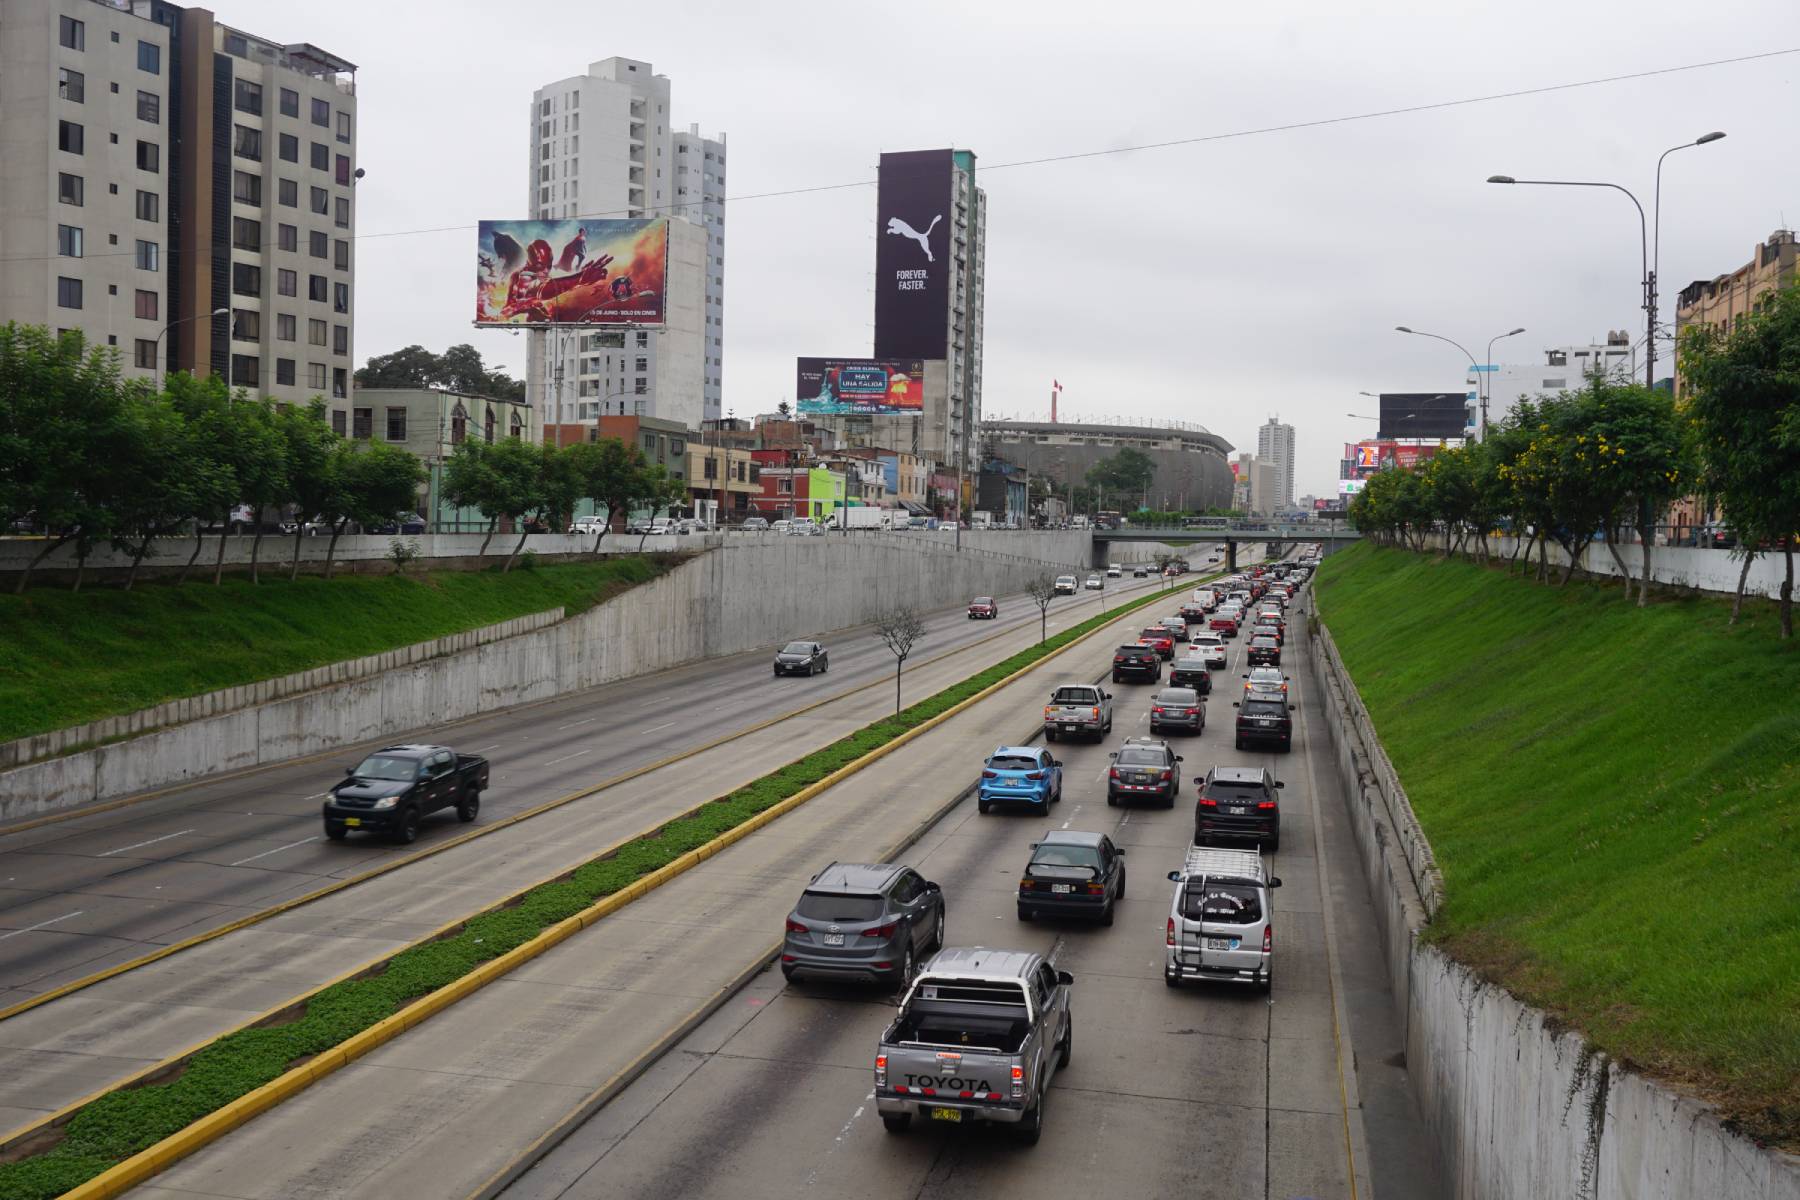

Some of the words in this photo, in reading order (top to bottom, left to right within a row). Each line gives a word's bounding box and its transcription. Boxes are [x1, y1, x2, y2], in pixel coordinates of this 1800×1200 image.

[896, 269, 929, 280] FOREVER.
[898, 280, 926, 291] FASTER.
[904, 1073, 992, 1093] TOYOTA
